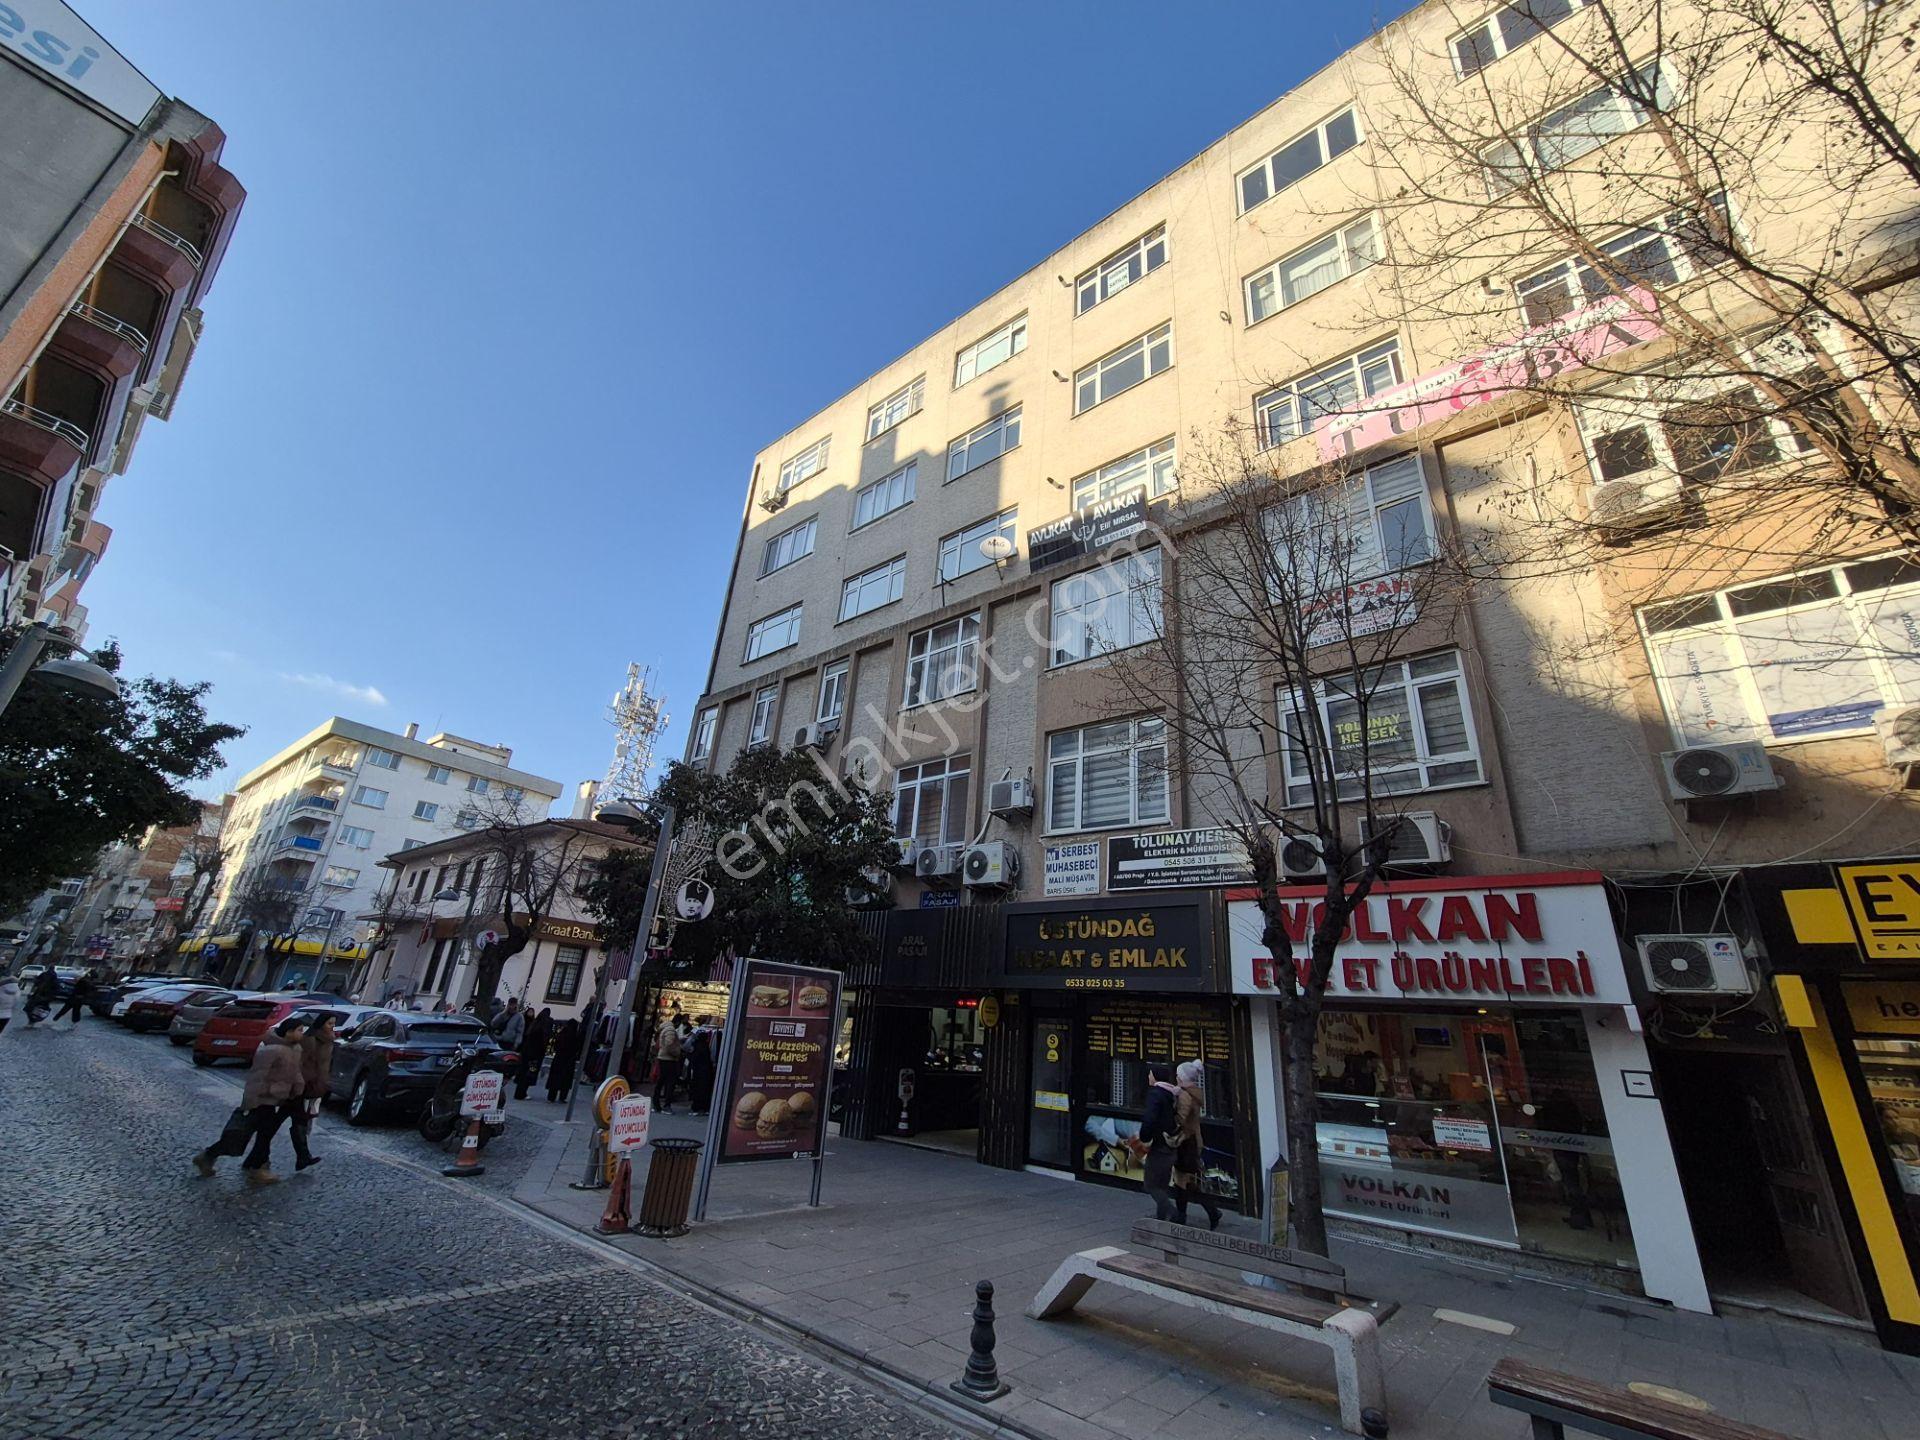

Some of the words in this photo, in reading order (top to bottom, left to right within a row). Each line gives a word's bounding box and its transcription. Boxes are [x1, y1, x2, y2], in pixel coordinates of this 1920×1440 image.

[1092, 488, 1143, 521] AVUKAT
[1029, 516, 1075, 546] AVUKAT
[1132, 830, 1192, 849] TOLUNAY
[1061, 843, 1098, 857] SERBEST
[1144, 847, 1179, 857] ELEKTRİK
[1180, 847, 1186, 855] &
[1045, 856, 1098, 873] MUHASEBECİ
[1163, 859, 1181, 867] 0545
[1065, 873, 1096, 884] MÜŞAVİR
[540, 921, 571, 938] Ziraat
[1039, 912, 1156, 941] ÜSTÜNDAĞ
[203, 944, 216, 957] P
[1090, 951, 1104, 969] &
[1108, 947, 1188, 969] EMLAK
[1341, 957, 1384, 991] ET
[1390, 950, 1597, 996] ÜRÜNLERİ
[1065, 978, 1085, 988] 0533
[1085, 978, 1101, 988] 025
[1102, 978, 1113, 988] 03
[1114, 978, 1125, 988] 35
[746, 1039, 774, 1050] Sokak
[776, 1039, 821, 1052] Lezzetinin
[759, 1050, 779, 1062] Yeni
[780, 1051, 809, 1063] Adresi
[614, 1120, 647, 1136] KUYUMCULUK
[1341, 1172, 1451, 1205] VOLKAN
[1345, 1194, 1359, 1204] Et
[1361, 1197, 1377, 1207] ve
[1379, 1199, 1393, 1210] Et
[1169, 1225, 1227, 1247] KIRKLARELİ
[1228, 1237, 1294, 1263] BELEDİYESİ
